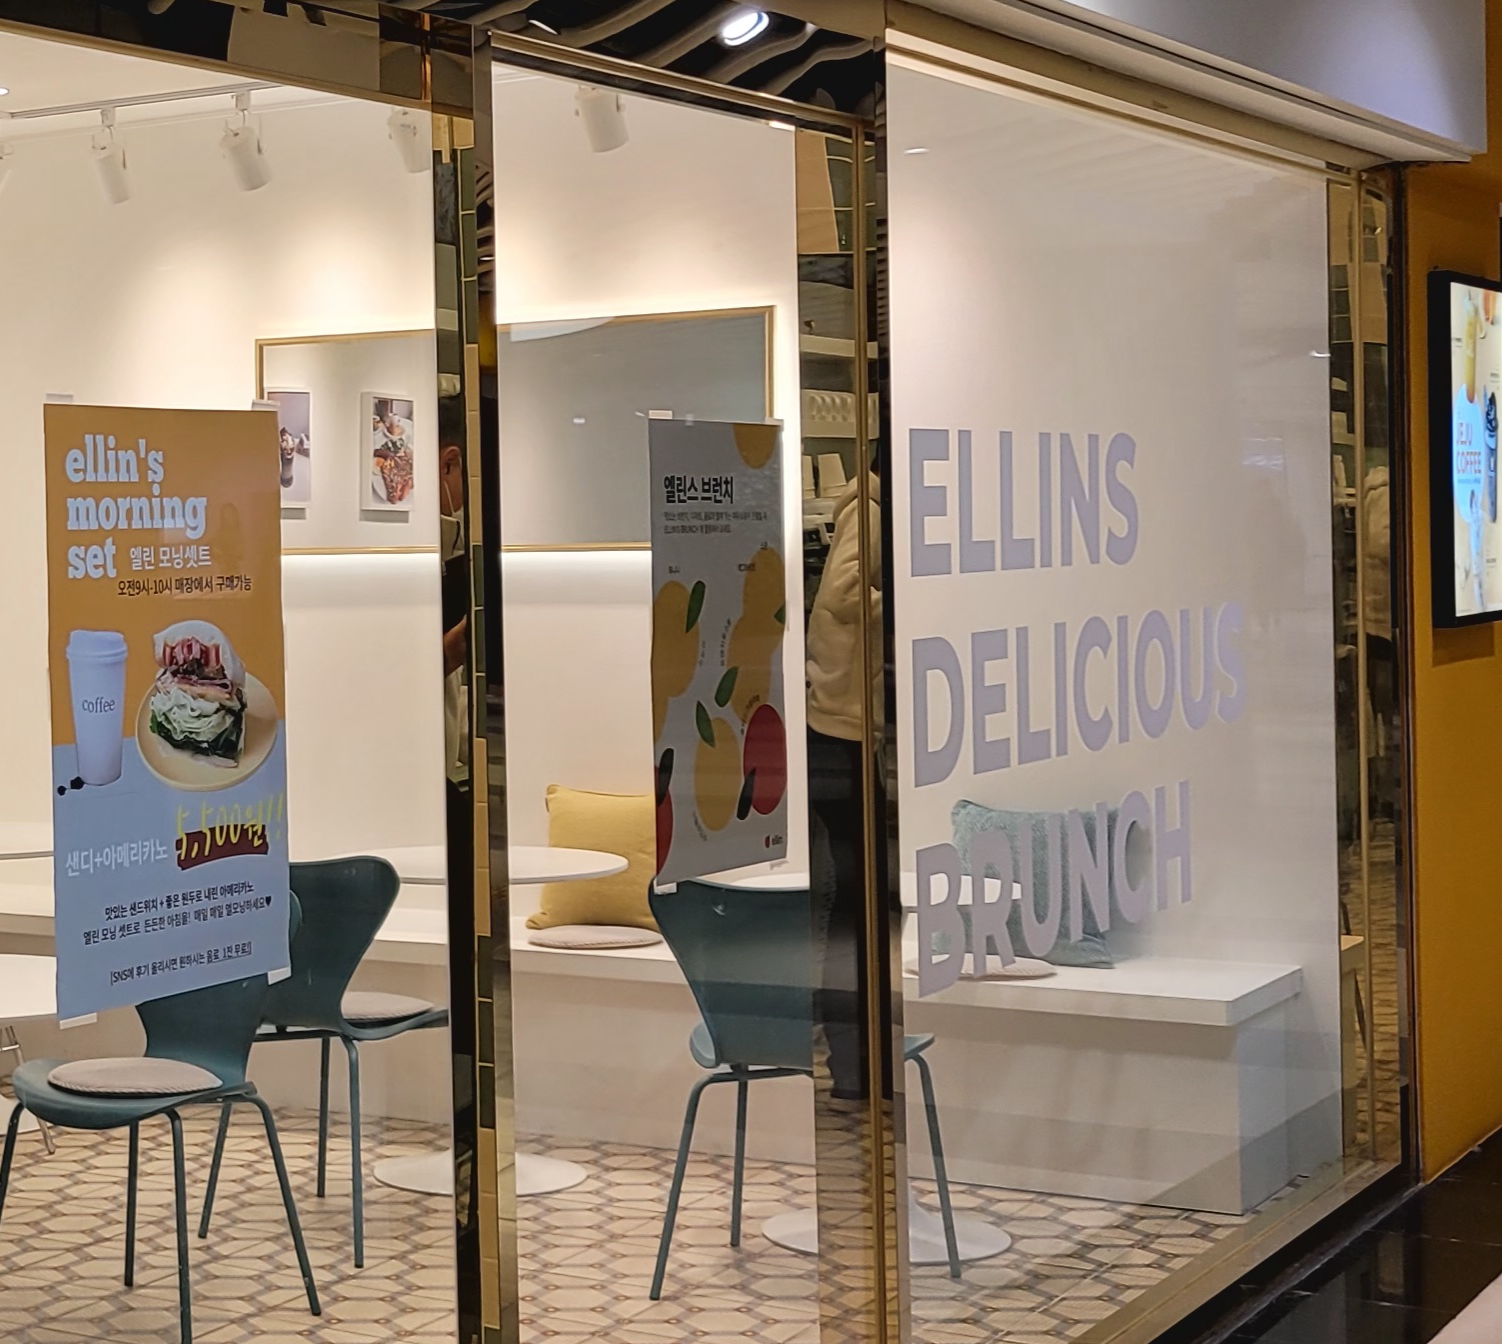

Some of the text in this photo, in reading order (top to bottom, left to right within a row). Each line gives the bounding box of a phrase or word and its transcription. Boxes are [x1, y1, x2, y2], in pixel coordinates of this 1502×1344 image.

[65, 433, 165, 483] ellin's
[663, 475, 734, 504] 엘린스 브런치
[908, 427, 1139, 578] ELLINS
[66, 483, 208, 540] morning
[67, 536, 117, 579] set
[130, 544, 212, 571] 엘린 모닝셋트
[174, 575, 214, 594] 매장에서
[215, 574, 252, 593] 구매가능
[82, 696, 116, 714] coffee
[911, 601, 1247, 789] DELICIOUS
[104, 903, 128, 922] 맛있는
[182, 890, 203, 907] 원두로
[220, 881, 254, 899] 아메리카노
[915, 779, 1192, 999] BRUNCH
[101, 925, 117, 941] 모닝
[144, 916, 166, 933] 든든한
